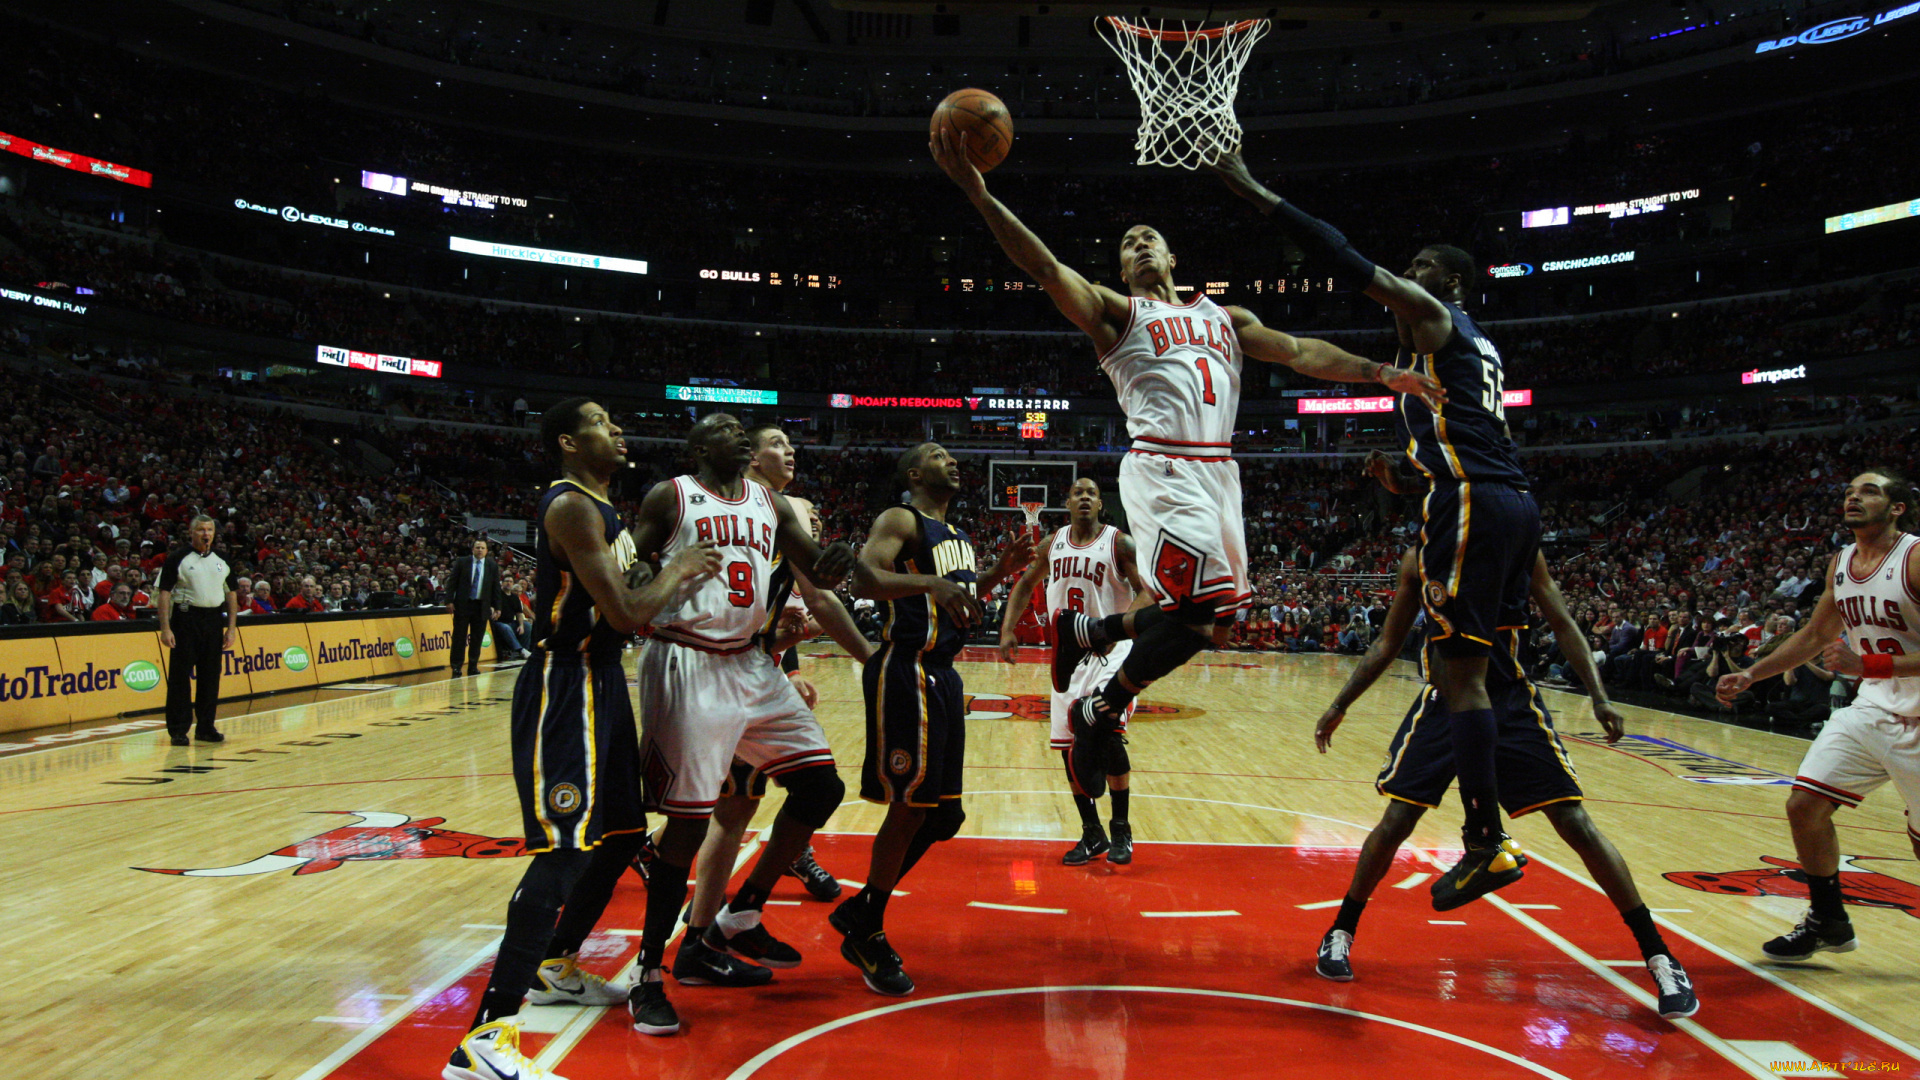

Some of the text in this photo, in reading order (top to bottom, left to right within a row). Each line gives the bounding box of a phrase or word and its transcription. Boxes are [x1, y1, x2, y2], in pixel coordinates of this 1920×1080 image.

[1755, 35, 1797, 53] BUD
[1809, 18, 1869, 41] LIGHT
[411, 182, 430, 194] JOSH
[463, 191, 499, 204] STRAIGHT
[500, 196, 510, 205] TO
[511, 198, 528, 208] YOU
[1573, 205, 1593, 216] JOSH
[1629, 194, 1668, 209] STRAIGHT
[1669, 193, 1681, 202] TO
[1681, 189, 1700, 200] YOU
[246, 203, 278, 215] LEXUS
[301, 213, 349, 229] LEXUS
[364, 226, 395, 236] LEXUS
[492, 245, 545, 262] Hinckley
[1542, 251, 1635, 272] CSNCHICAGO.COM
[699, 269, 760, 282] GO BULLS
[1490, 265, 1522, 274] comcast
[963, 283, 974, 291] 52
[1003, 282, 1023, 291] 5:39
[1206, 281, 1230, 289] PACERS
[0, 288, 87, 314] VERY OWN PLAY
[1146, 316, 1231, 365] BULLS
[1195, 357, 1216, 407] 1
[1753, 364, 1806, 384] impact
[693, 386, 763, 397] RUSH UNIVERSITY
[1481, 359, 1504, 421] 55
[855, 397, 898, 407] NOAH'S
[900, 397, 963, 408] REBOUNDS
[1304, 399, 1352, 414] Majestic
[1353, 399, 1377, 411] Star
[1026, 412, 1045, 422] 5:39
[694, 514, 771, 562] BULLS
[1053, 556, 1106, 587] BULLS
[727, 561, 754, 608] 9
[1067, 587, 1084, 615] 6
[1837, 594, 1909, 632] BULLS
[285, 654, 308, 665] .com
[317, 636, 395, 665] AutoTrader
[125, 667, 158, 684] .com
[99, 732, 363, 786] UNITED
